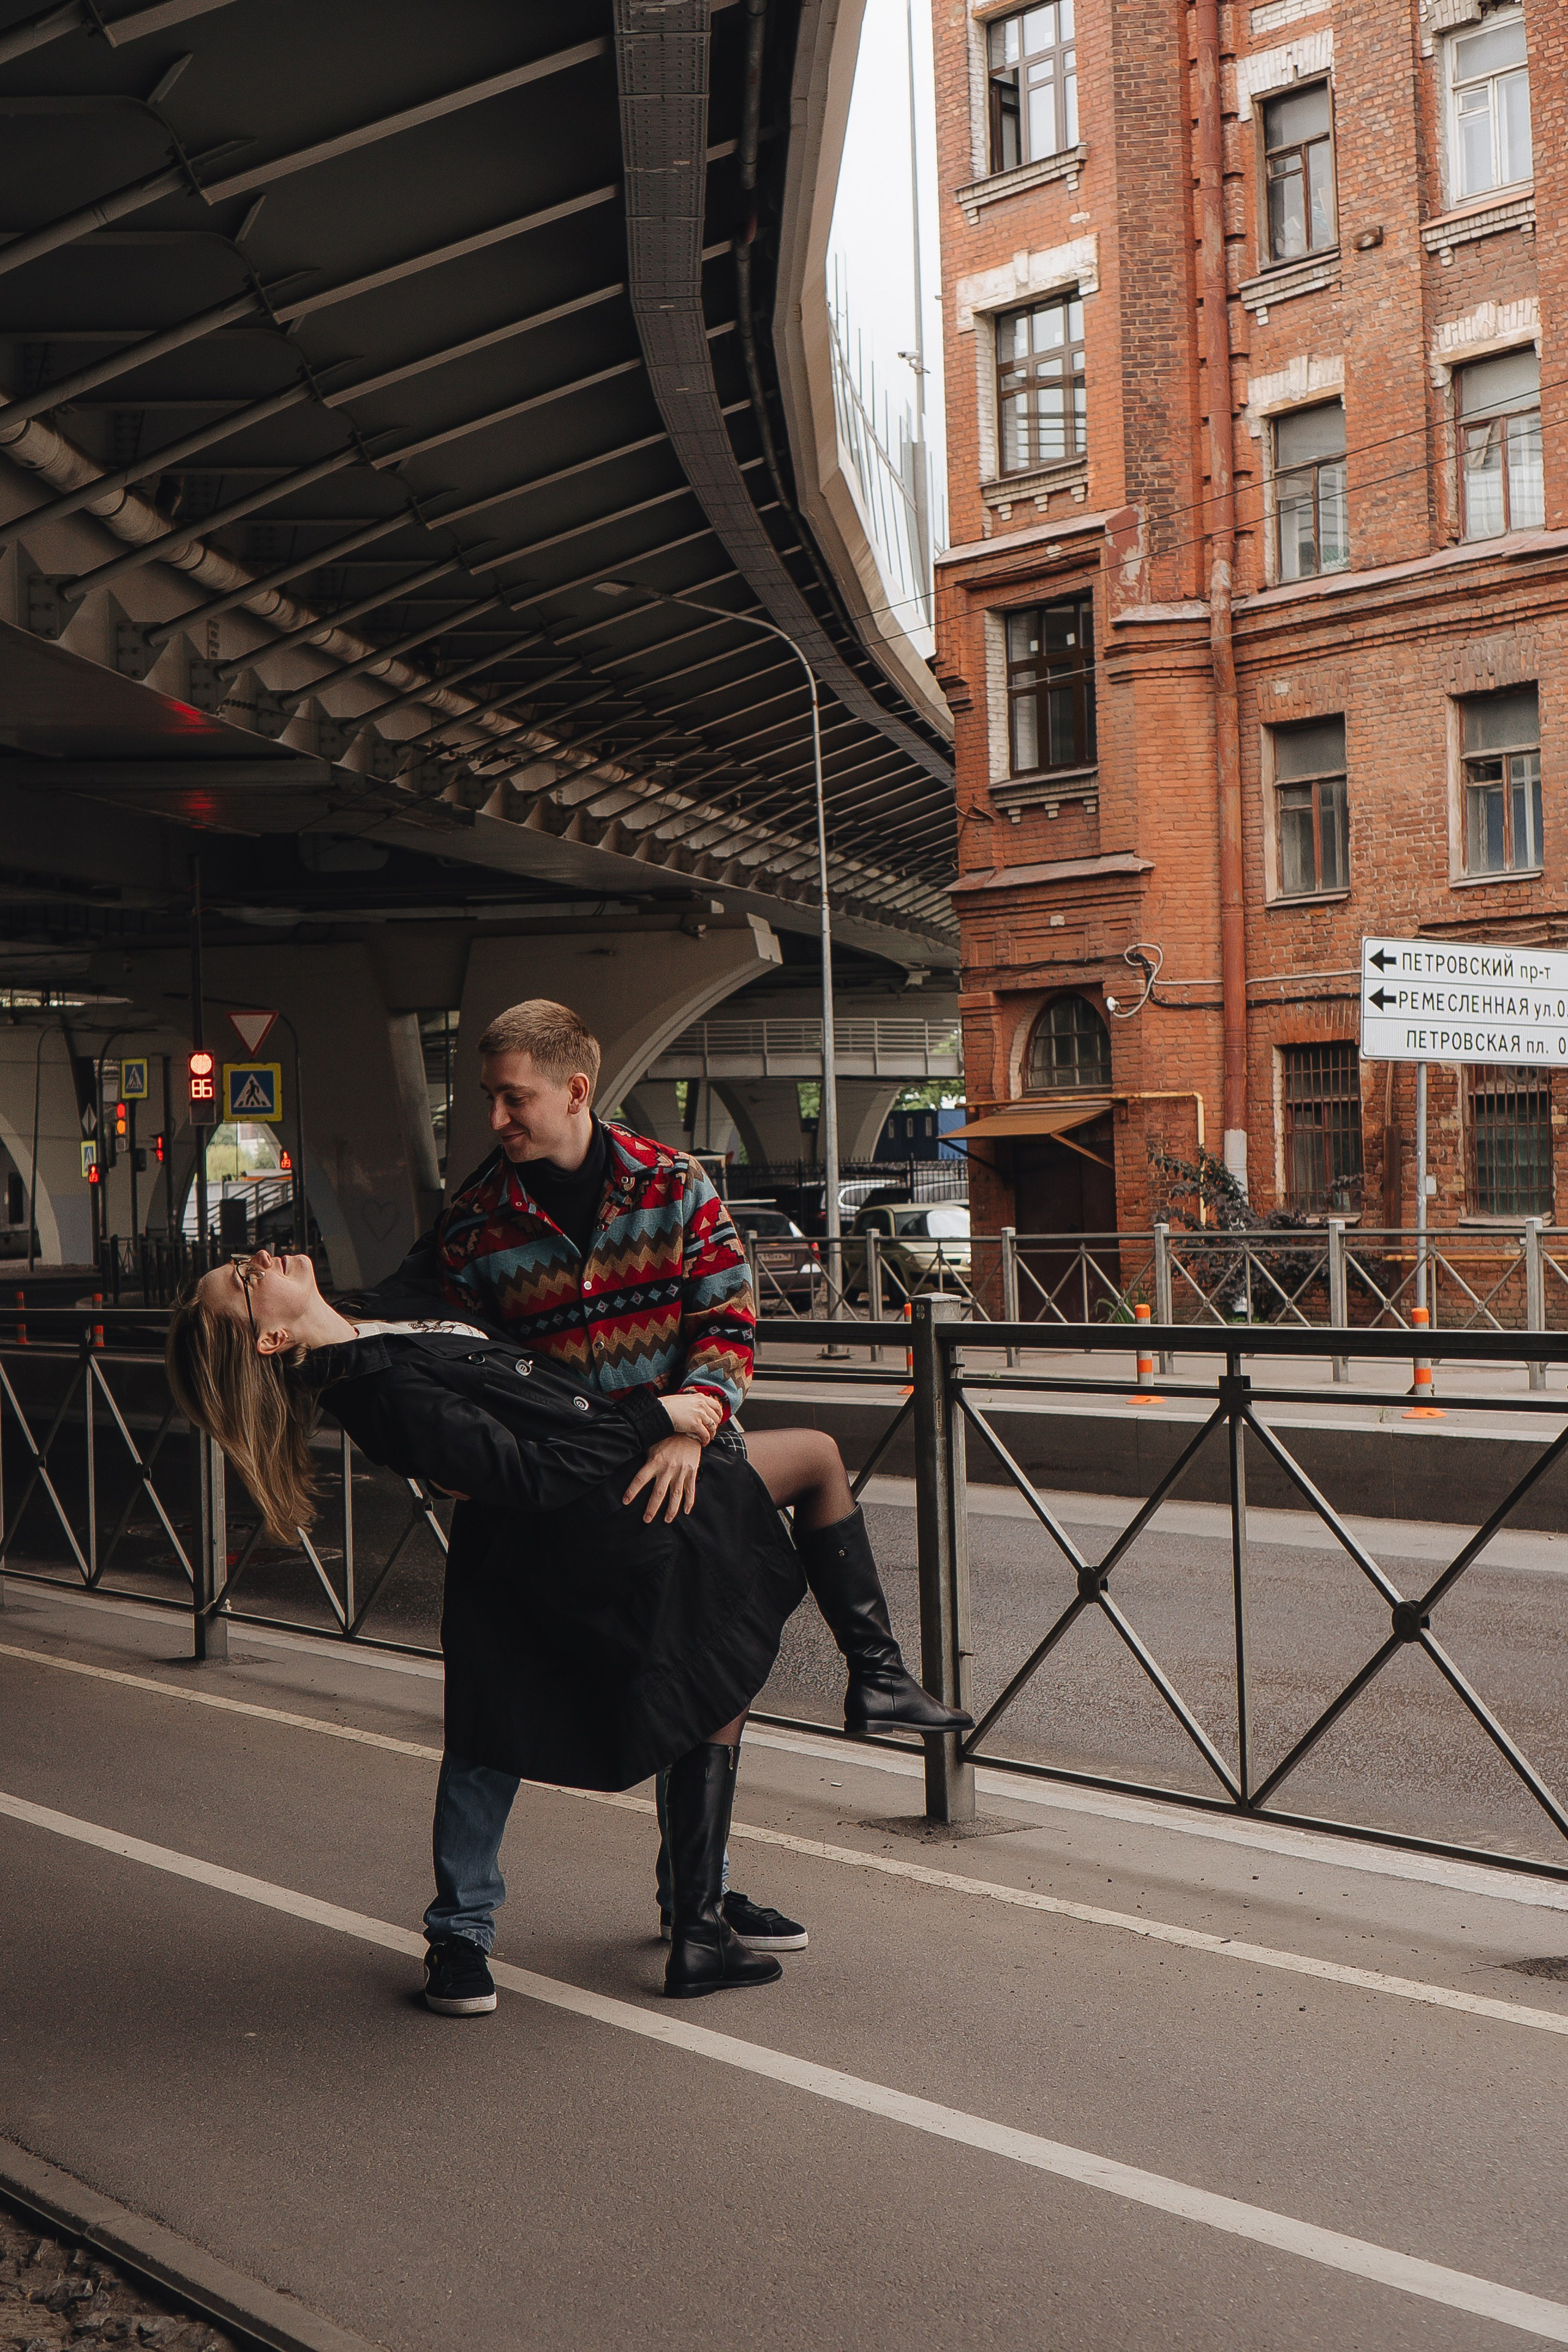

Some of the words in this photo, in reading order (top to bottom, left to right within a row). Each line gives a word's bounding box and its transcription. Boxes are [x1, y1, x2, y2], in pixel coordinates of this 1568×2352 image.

[1403, 952, 1513, 977] ПЕТРОВСКИЙ
[1520, 965, 1551, 983] пр-т
[1399, 990, 1528, 1016] РЕМЕСЛЕННАЯ
[1406, 1030, 1520, 1053] ПЕТРОВСКАЯ
[1526, 1041, 1549, 1054] пл.
[192, 1079, 213, 1098] 86
